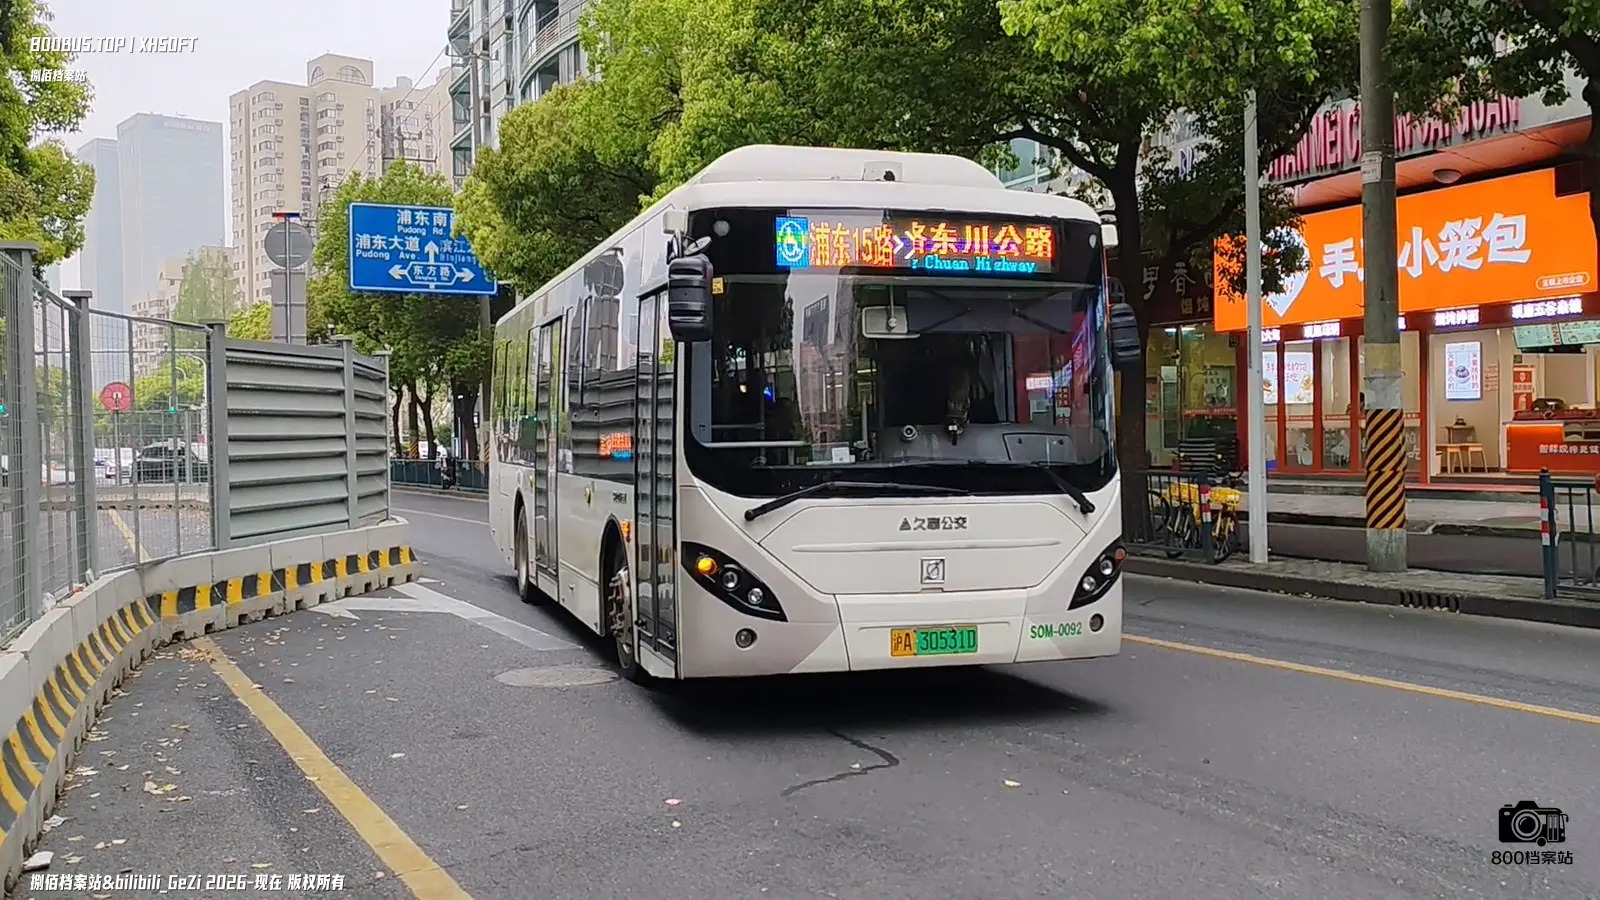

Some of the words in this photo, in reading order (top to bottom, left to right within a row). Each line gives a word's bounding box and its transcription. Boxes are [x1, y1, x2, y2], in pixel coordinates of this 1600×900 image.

[397, 225, 427, 236] Pudong
[355, 233, 420, 252] 浦东大道
[809, 222, 896, 268] 浦东15路
[355, 250, 390, 260] Pudong
[399, 251, 421, 260] Ave.
[924, 254, 969, 270] Chuan
[413, 265, 451, 277] 东方路
[893, 631, 913, 651] 沪A
[919, 628, 977, 651] 30531D
